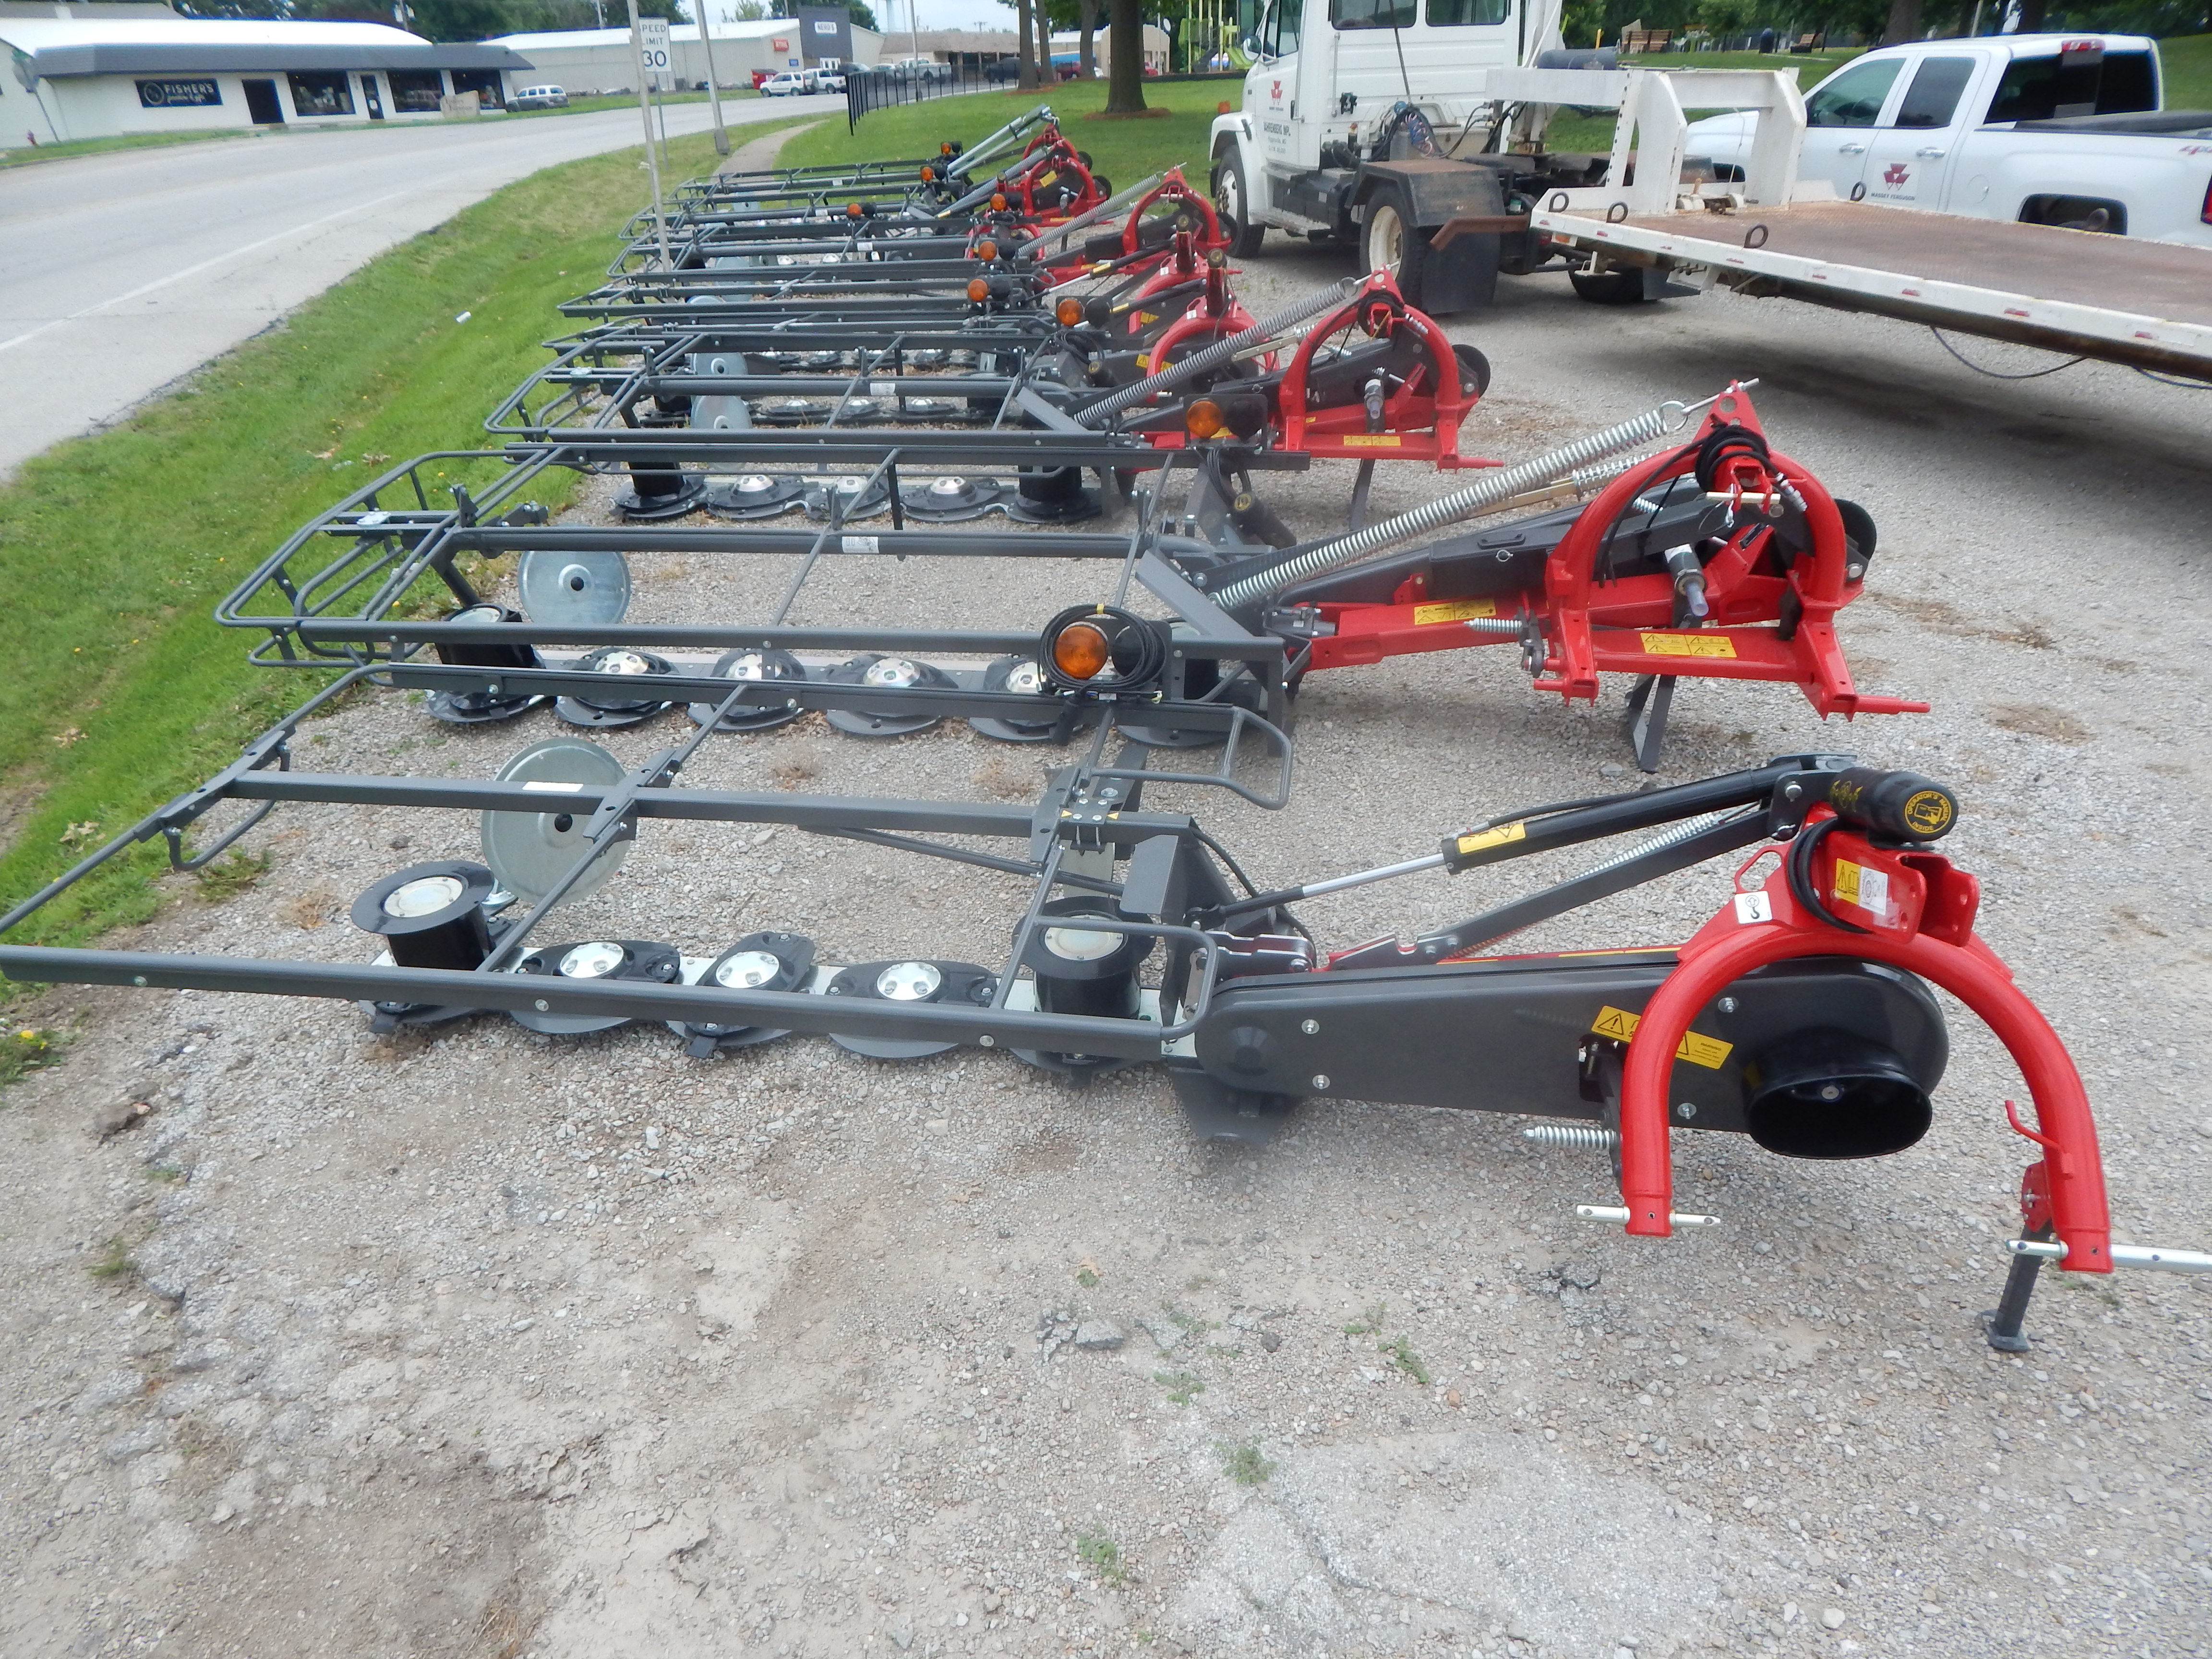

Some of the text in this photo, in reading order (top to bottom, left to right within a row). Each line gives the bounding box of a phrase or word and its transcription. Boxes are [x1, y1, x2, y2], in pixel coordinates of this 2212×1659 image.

[640, 24, 666, 33] PEED
[642, 50, 667, 67] 30
[164, 83, 215, 94] FISHER'S
[1907, 793, 1948, 821] OPERATOR'S MANUAL
[1912, 821, 1934, 831] INSIDE
